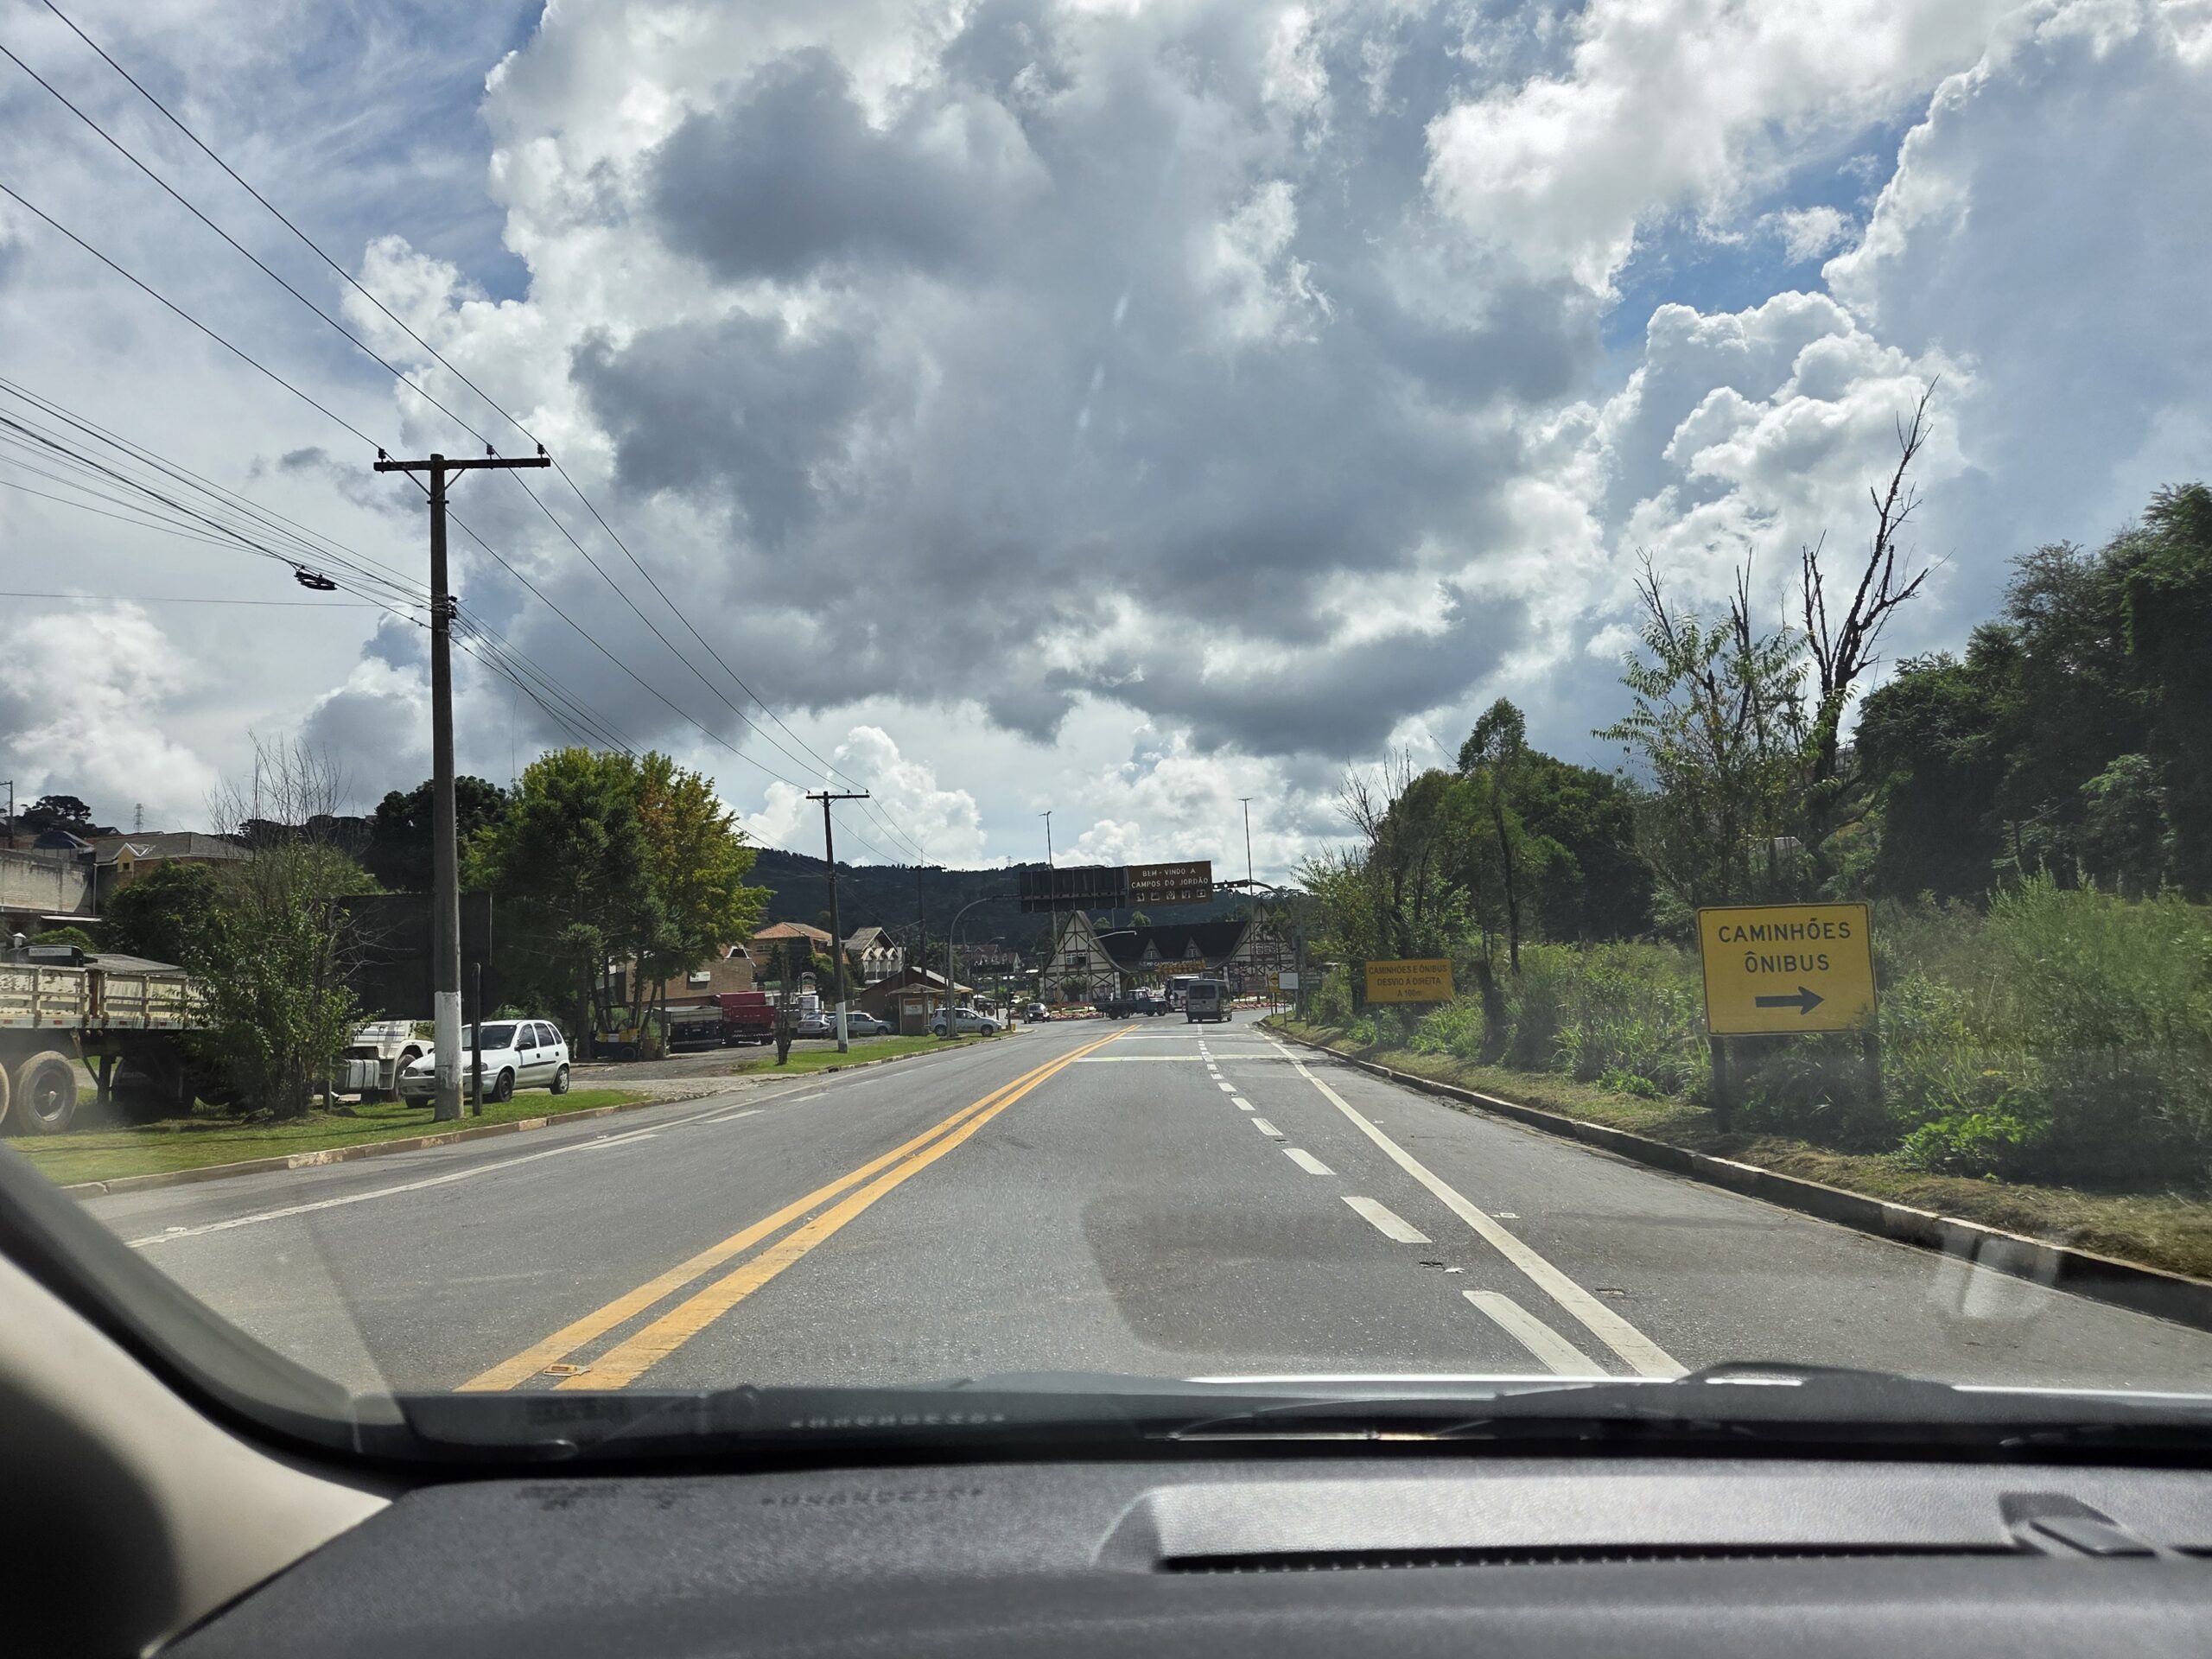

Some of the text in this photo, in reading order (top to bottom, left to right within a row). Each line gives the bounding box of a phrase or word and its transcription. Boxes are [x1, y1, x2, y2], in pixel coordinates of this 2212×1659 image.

[1131, 880, 1161, 889] CAMPOS
[1179, 876, 1209, 886] JORDÃO
[1719, 918, 1851, 943] CAMINHÕES
[1744, 950, 1830, 974] ÔNIBUS
[1369, 963, 1447, 975] CAMINHÕES E ÔNIBUS
[1376, 977, 1404, 987] DESVIO
[1413, 976, 1441, 986] DIREITA
